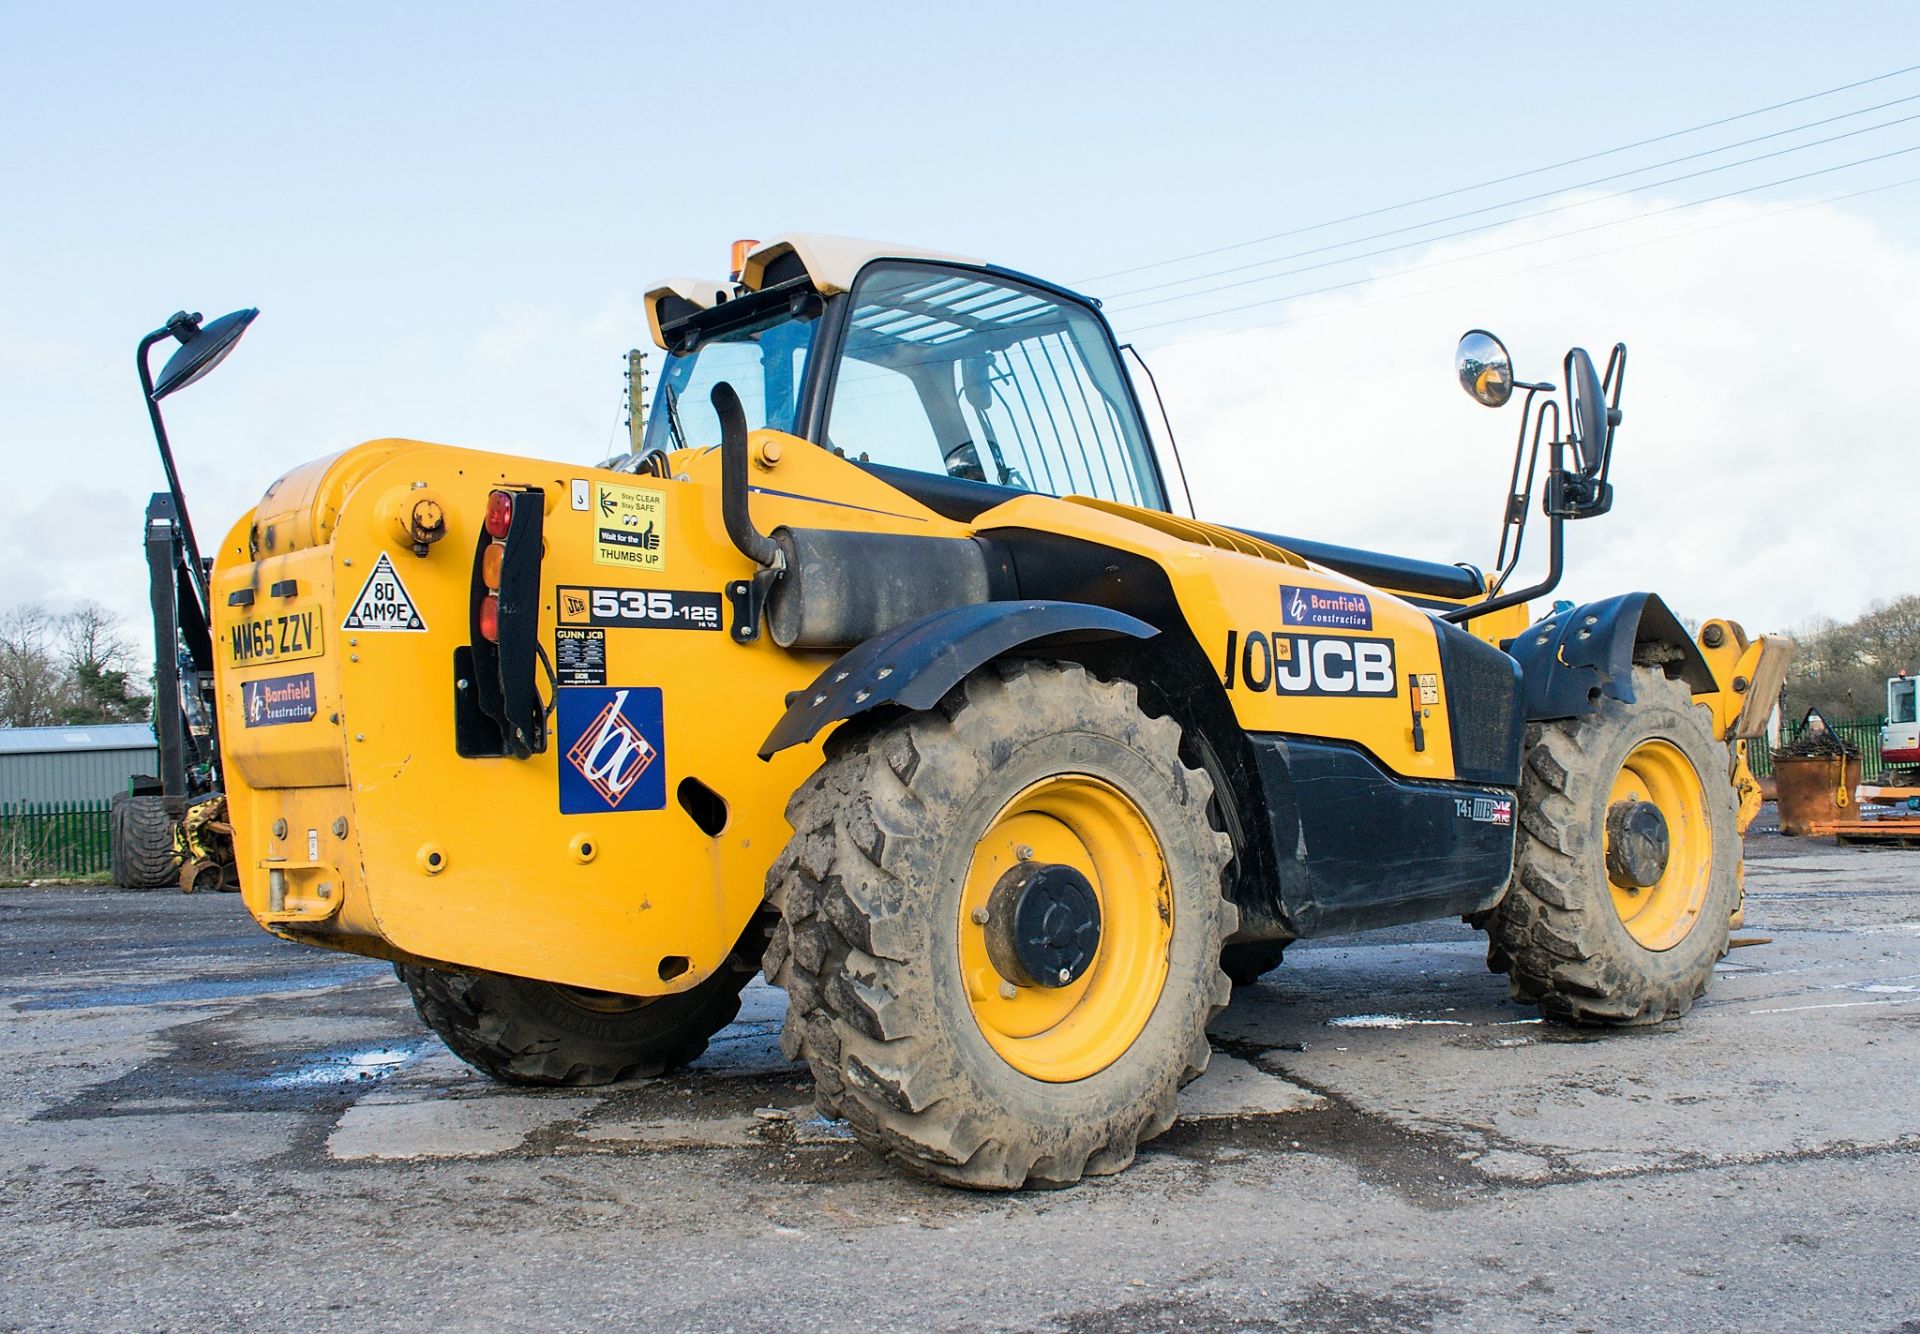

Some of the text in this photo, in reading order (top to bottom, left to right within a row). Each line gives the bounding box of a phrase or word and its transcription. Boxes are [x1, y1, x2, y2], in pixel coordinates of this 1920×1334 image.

[621, 493, 660, 504] Stay CLEAR
[621, 502, 655, 512] Stay SAFE
[601, 531, 639, 543] Wait for the
[600, 548, 659, 564] THUMBS UP
[363, 602, 408, 621] AM9E
[568, 598, 585, 614] JCB
[592, 590, 717, 620] 535-125
[1311, 594, 1366, 613] Barnfield
[1312, 613, 1366, 626] construction
[231, 611, 313, 661] MM65 ZZV
[557, 630, 603, 640] GUNN JCB
[1277, 639, 1395, 692] JCB
[265, 680, 311, 703] Barnfield
[266, 703, 312, 719] construction
[1454, 798, 1473, 818] T4i
